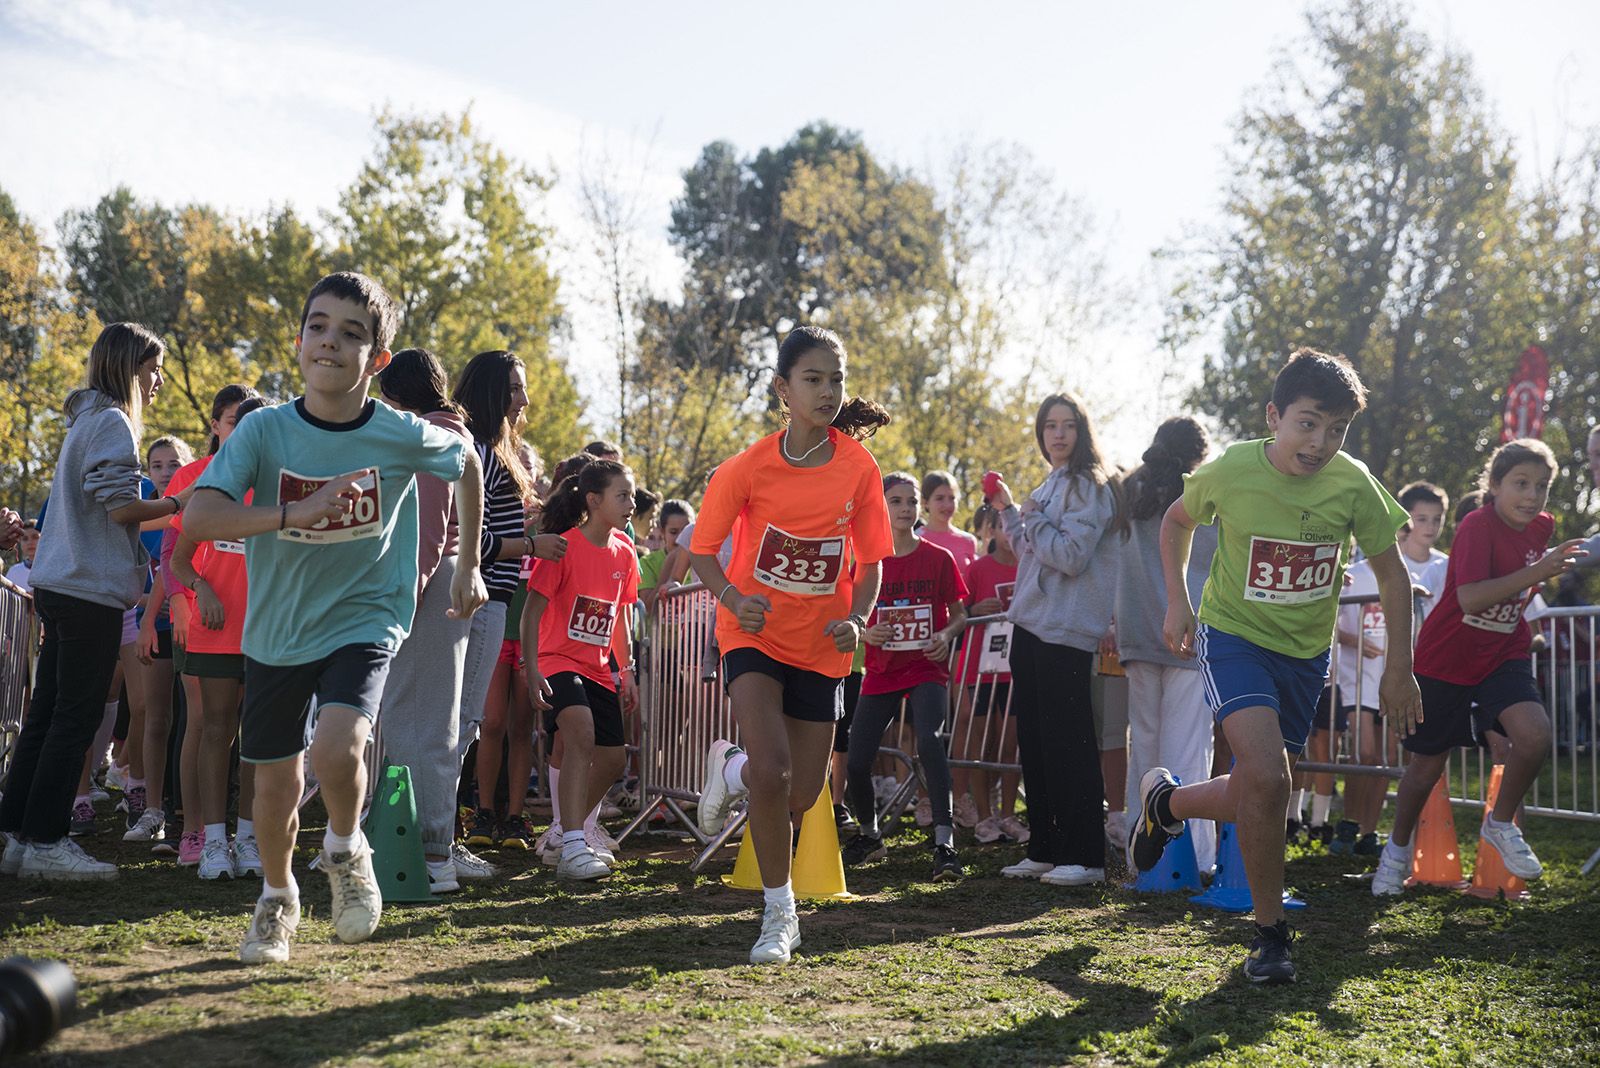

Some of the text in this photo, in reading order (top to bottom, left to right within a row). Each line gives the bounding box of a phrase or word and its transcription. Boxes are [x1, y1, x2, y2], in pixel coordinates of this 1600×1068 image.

[771, 553, 828, 582] 233
[1254, 561, 1331, 590] 3140
[573, 612, 613, 636] 1021
